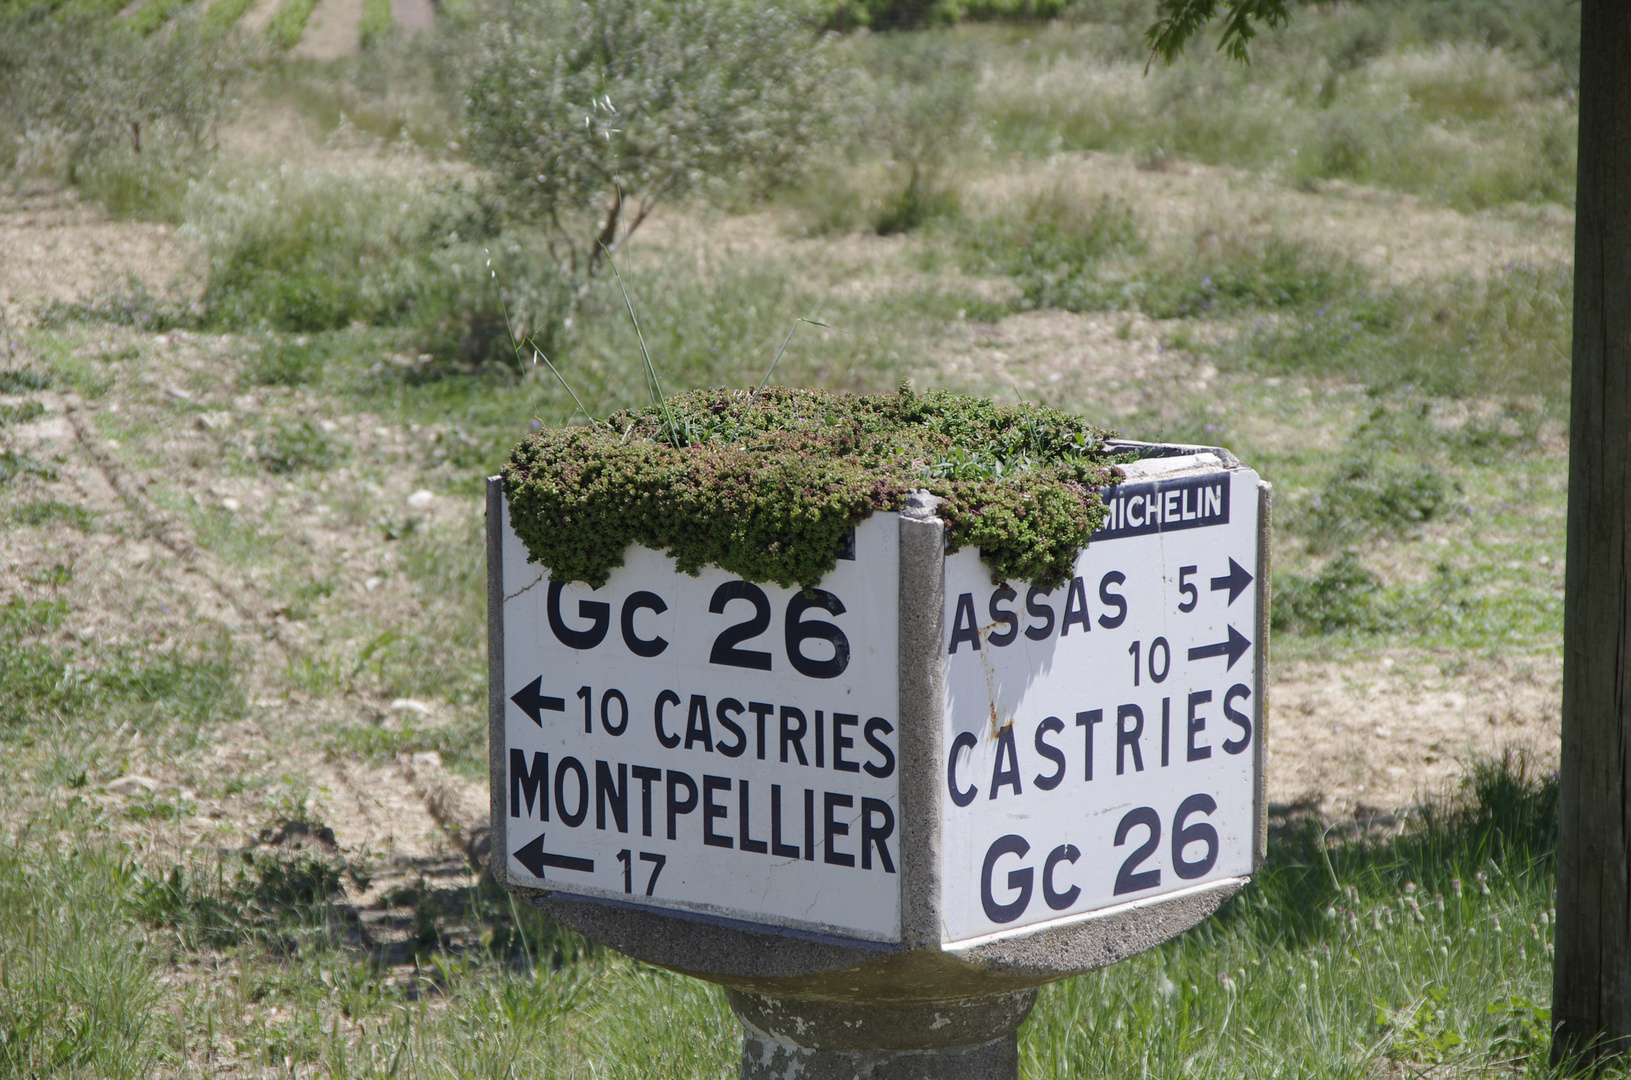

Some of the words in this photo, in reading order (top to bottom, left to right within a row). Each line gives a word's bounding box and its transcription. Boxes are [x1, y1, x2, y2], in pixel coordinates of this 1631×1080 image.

[709, 580, 850, 679] 26
[948, 570, 1127, 654] ASSAS
[1178, 565, 1198, 613] 5
[1128, 636, 1171, 687] 10
[576, 686, 629, 737] 10
[654, 689, 896, 779] CASTRIES
[947, 683, 1253, 808] CASTRIES
[510, 748, 896, 874] MONTPELLIER
[1113, 793, 1219, 896] 26
[616, 848, 667, 896] 17
